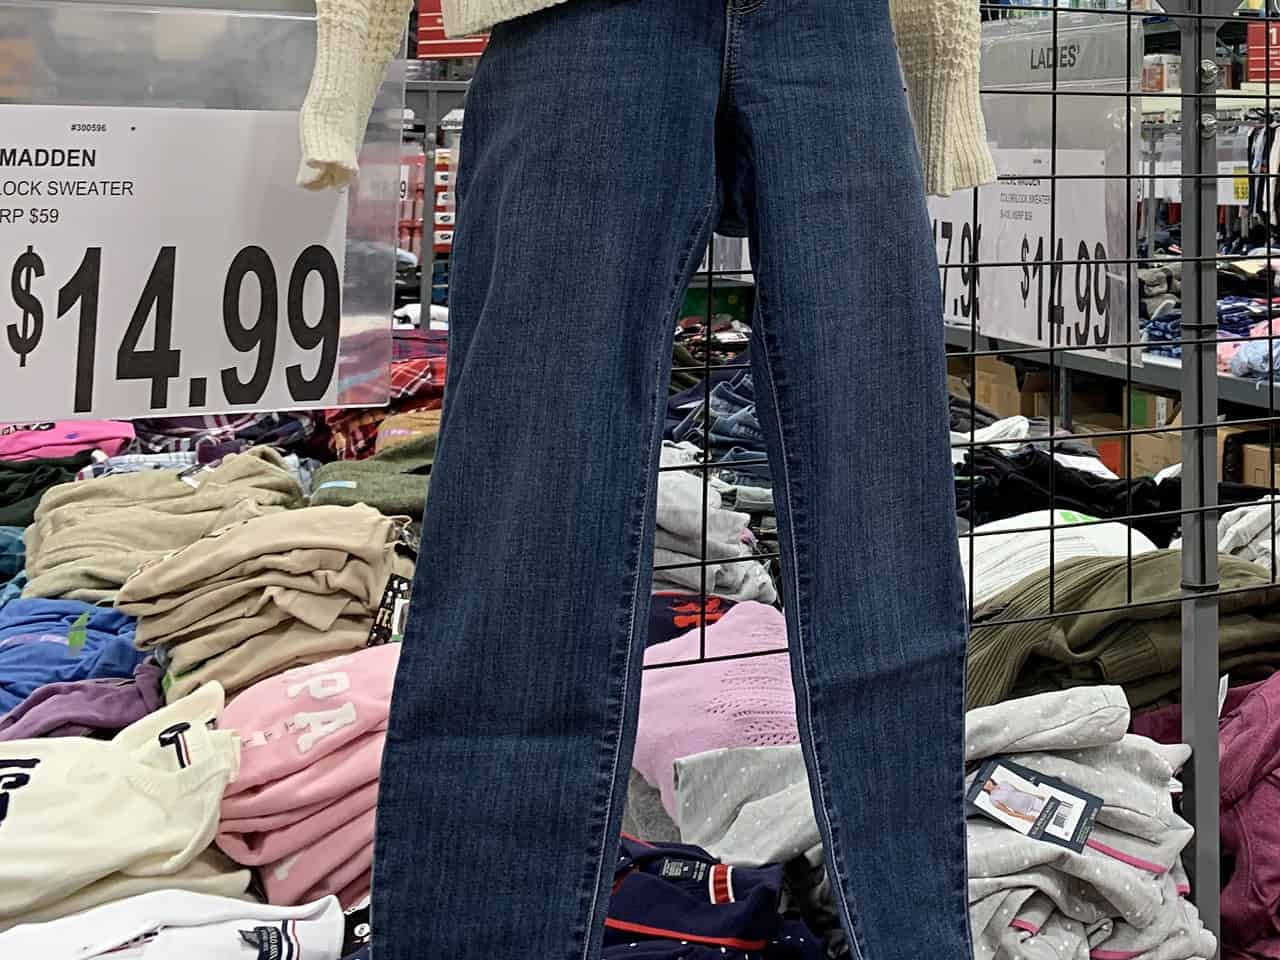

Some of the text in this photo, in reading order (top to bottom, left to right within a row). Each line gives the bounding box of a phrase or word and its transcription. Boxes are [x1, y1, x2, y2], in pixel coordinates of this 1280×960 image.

[1031, 45, 1080, 69] LADES'
[0, 148, 96, 167] MADDEN
[47, 180, 134, 196] SWEATER
[29, 208, 59, 224] $59
[1020, 233, 1111, 351] $14.99
[7, 244, 341, 413] $14.99
